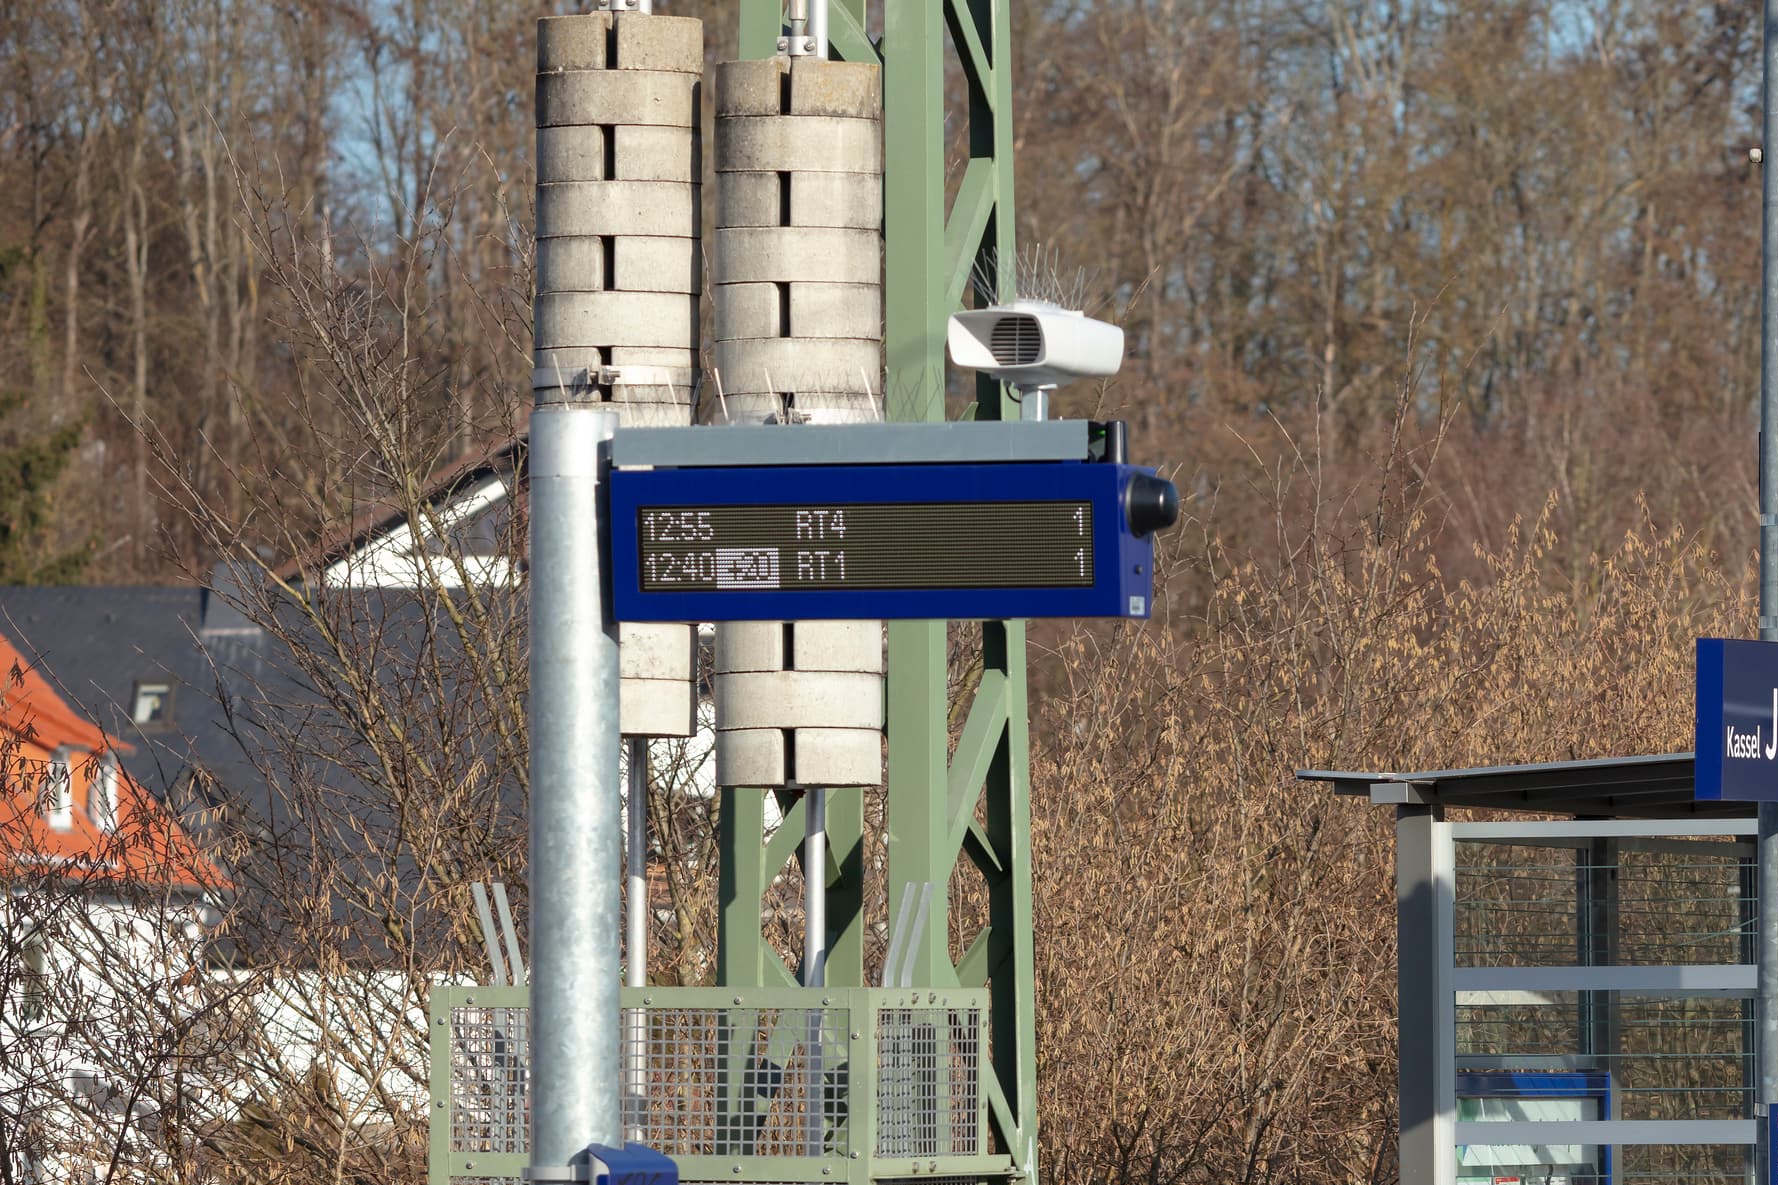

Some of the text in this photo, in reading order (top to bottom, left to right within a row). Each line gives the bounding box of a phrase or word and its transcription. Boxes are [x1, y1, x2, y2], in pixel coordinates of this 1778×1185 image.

[644, 507, 1083, 540] 12:55 RT4 1
[645, 548, 1084, 581] 12:40 +20 RT1 1
[1727, 726, 1761, 759] Kassel
